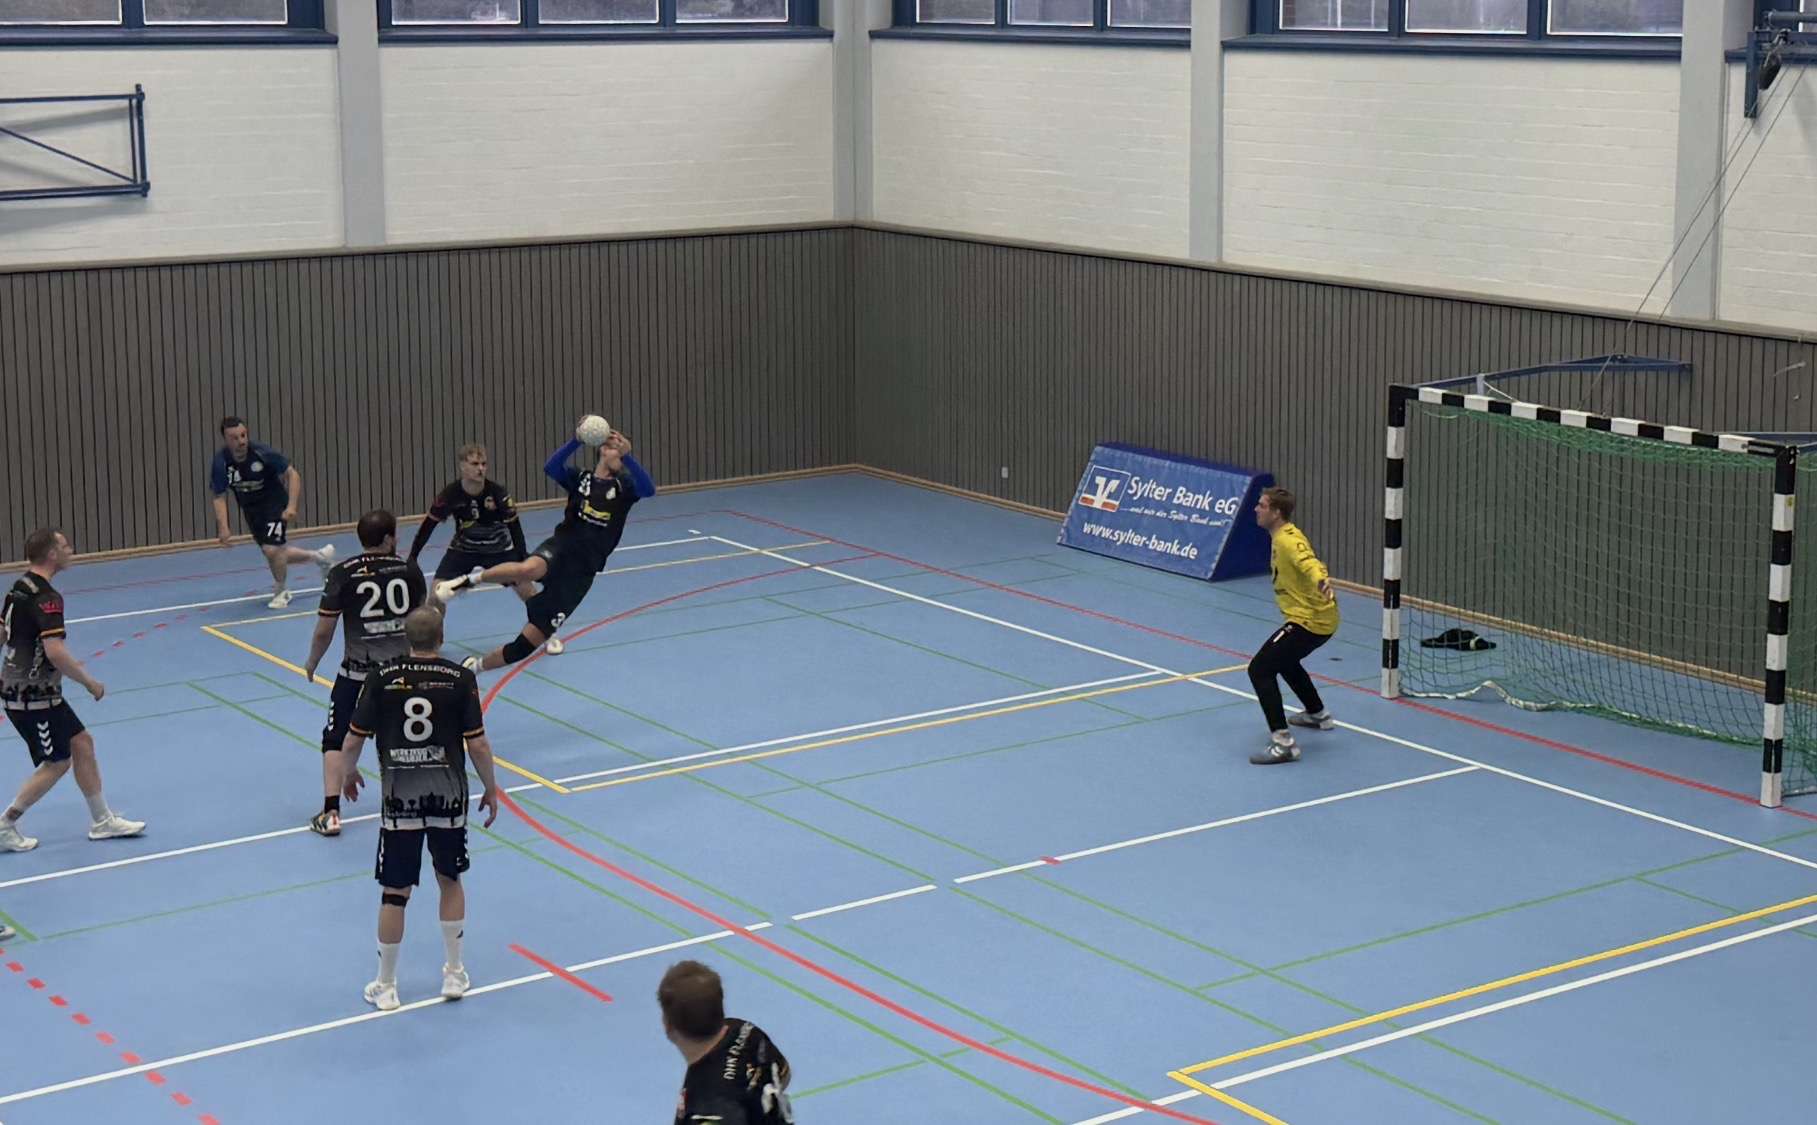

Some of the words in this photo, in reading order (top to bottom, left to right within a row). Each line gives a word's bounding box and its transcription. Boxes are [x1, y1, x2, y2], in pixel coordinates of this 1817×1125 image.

[1127, 476, 1172, 500] Sylter
[1173, 486, 1213, 511] Bank
[1214, 496, 1239, 515] eG
[267, 521, 283, 537] 74
[1083, 522, 1198, 559] www.sylter-bank.de
[356, 578, 410, 618] 20
[402, 663, 460, 678] FLENSBORG
[403, 697, 433, 742] 8
